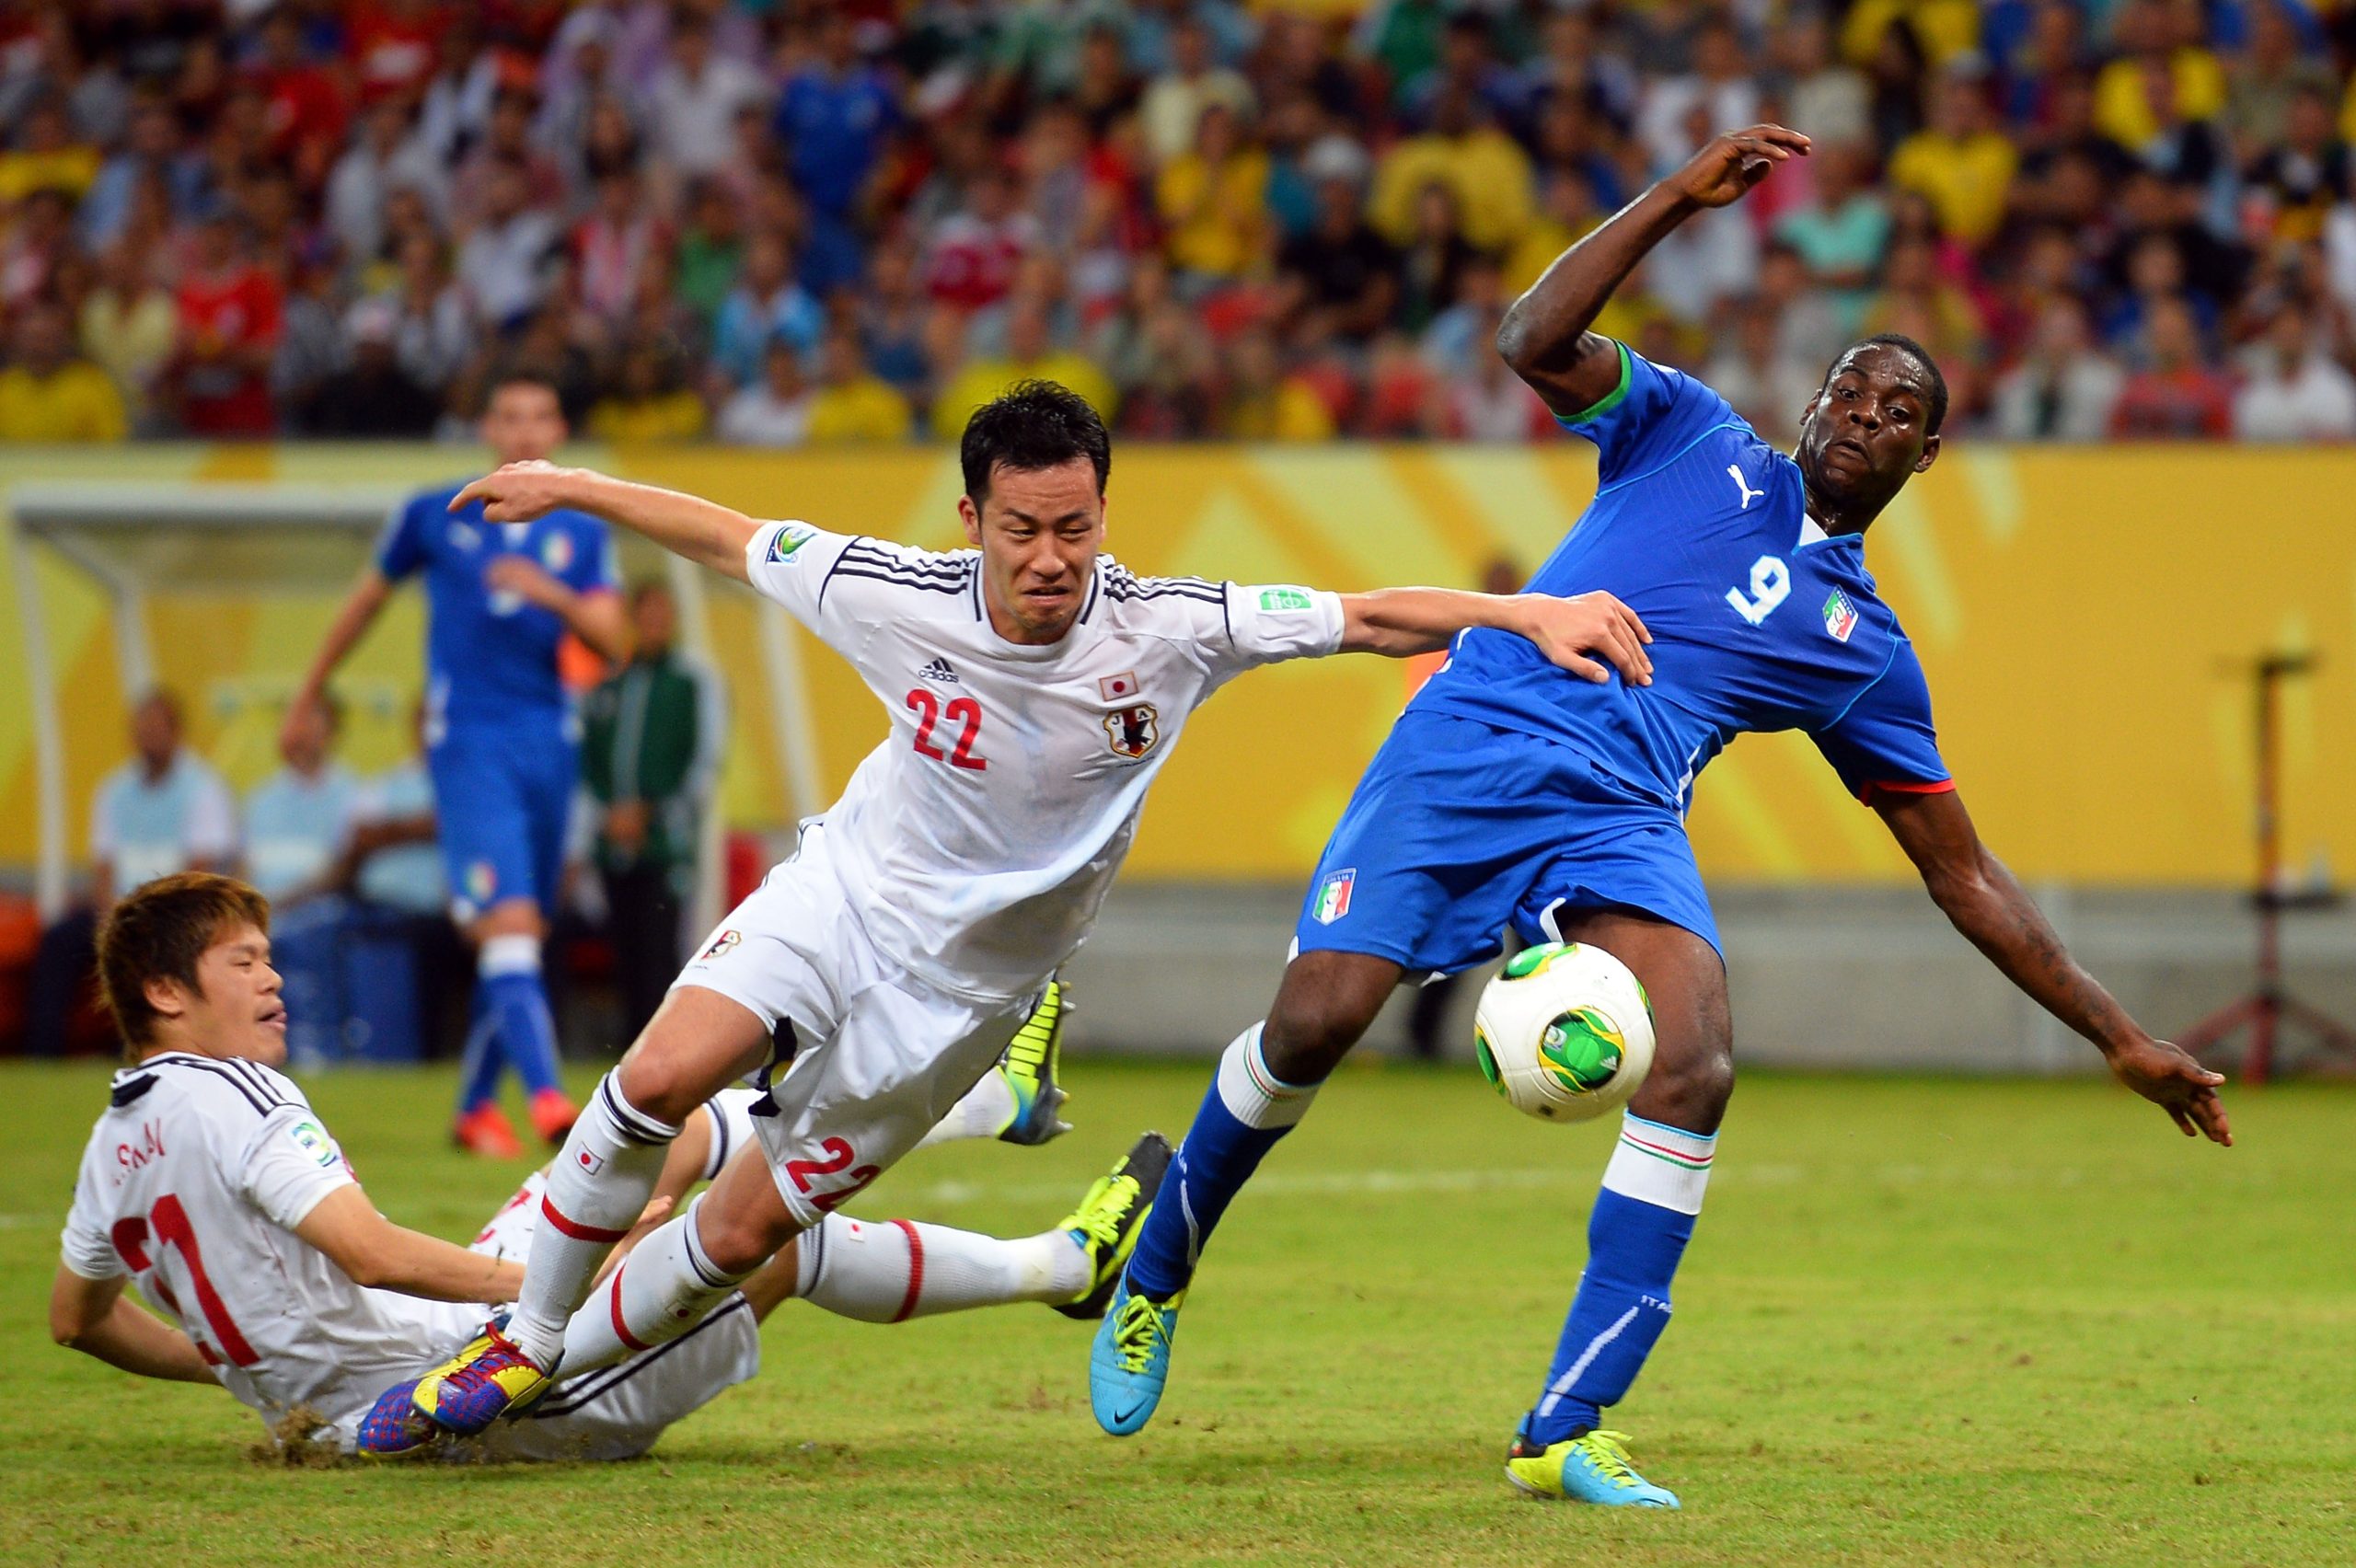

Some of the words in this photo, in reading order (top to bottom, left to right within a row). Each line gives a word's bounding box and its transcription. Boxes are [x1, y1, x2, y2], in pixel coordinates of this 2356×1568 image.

[1725, 555, 1791, 626] 9
[906, 688, 987, 771] 22
[785, 1136, 882, 1212] 22
